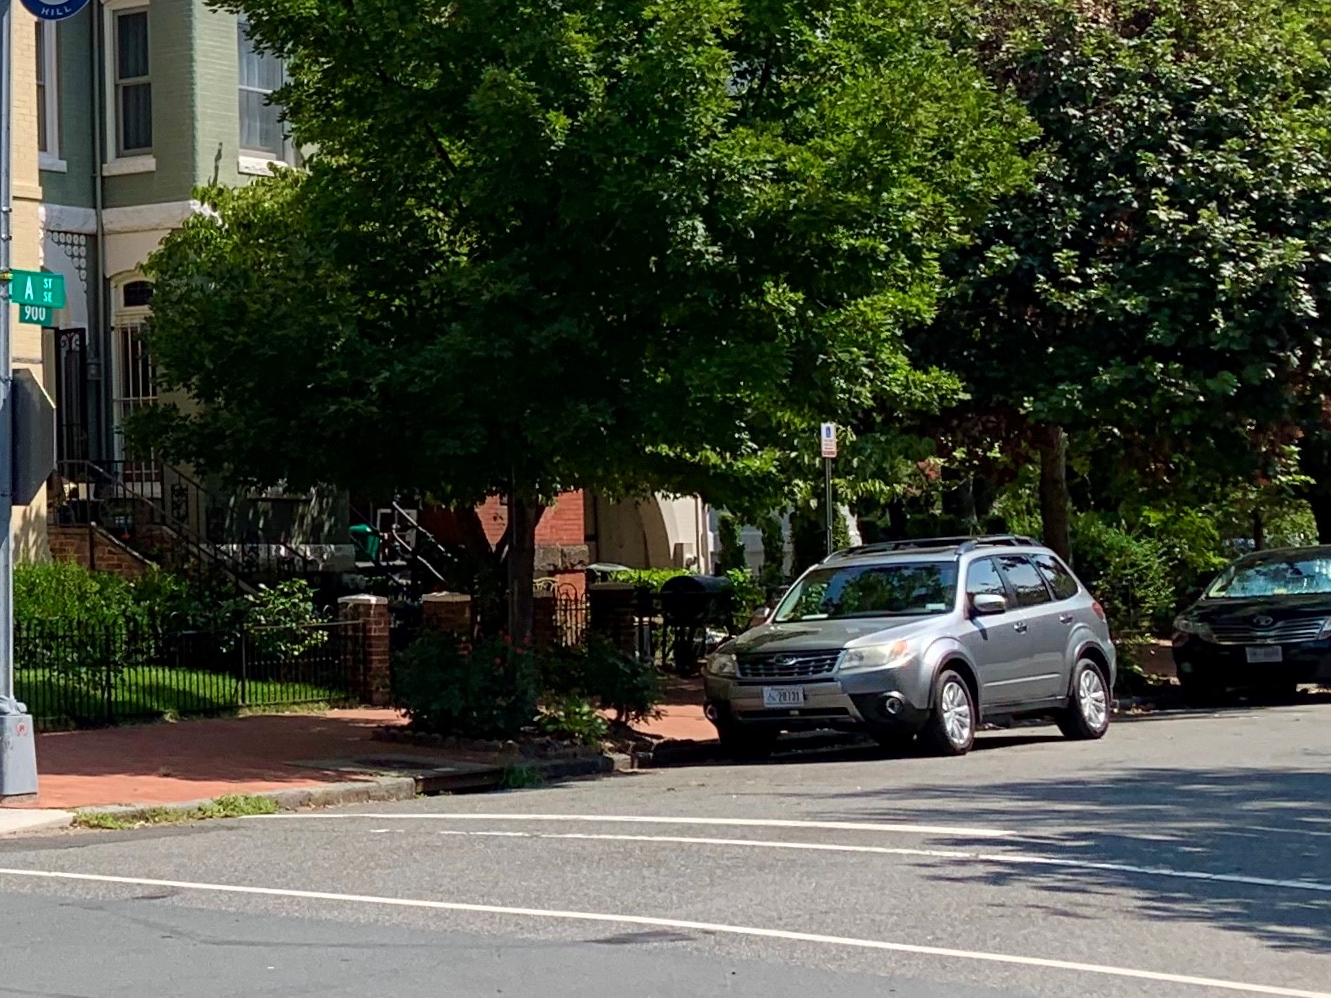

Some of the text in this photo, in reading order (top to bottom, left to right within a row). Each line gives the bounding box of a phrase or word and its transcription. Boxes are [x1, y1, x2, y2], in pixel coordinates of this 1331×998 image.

[41, 5, 71, 16] HILL
[24, 276, 52, 301] A ST
[43, 292, 52, 303] SE
[24, 306, 46, 321] 900
